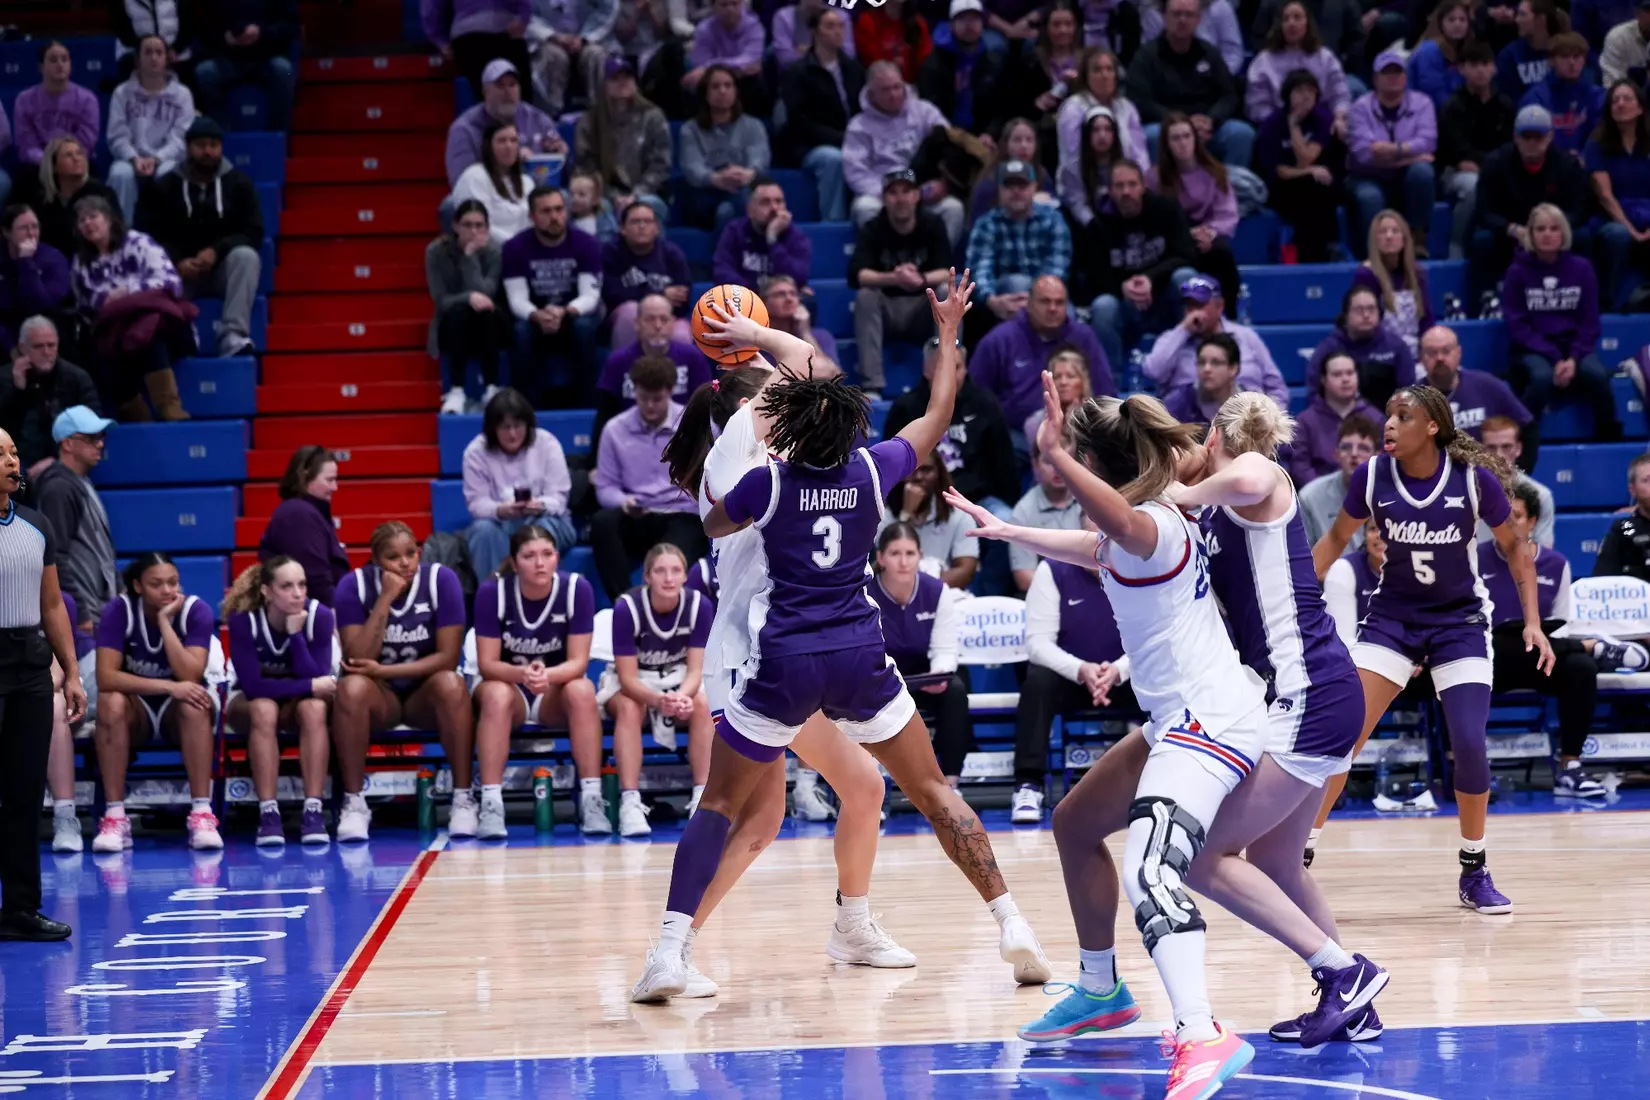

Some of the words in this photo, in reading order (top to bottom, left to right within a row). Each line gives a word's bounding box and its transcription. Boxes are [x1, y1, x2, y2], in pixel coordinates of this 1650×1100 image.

[799, 487, 858, 512] HARROD
[811, 515, 843, 570] 3
[1384, 517, 1462, 545] Wildcats
[1410, 550, 1437, 586] 5
[1574, 584, 1647, 604] Capitol
[960, 609, 1025, 629] apitol
[1575, 603, 1648, 621] Federal
[383, 623, 430, 643] ildcats
[502, 631, 563, 655] Wildcats
[63, 886, 326, 997] COURT
